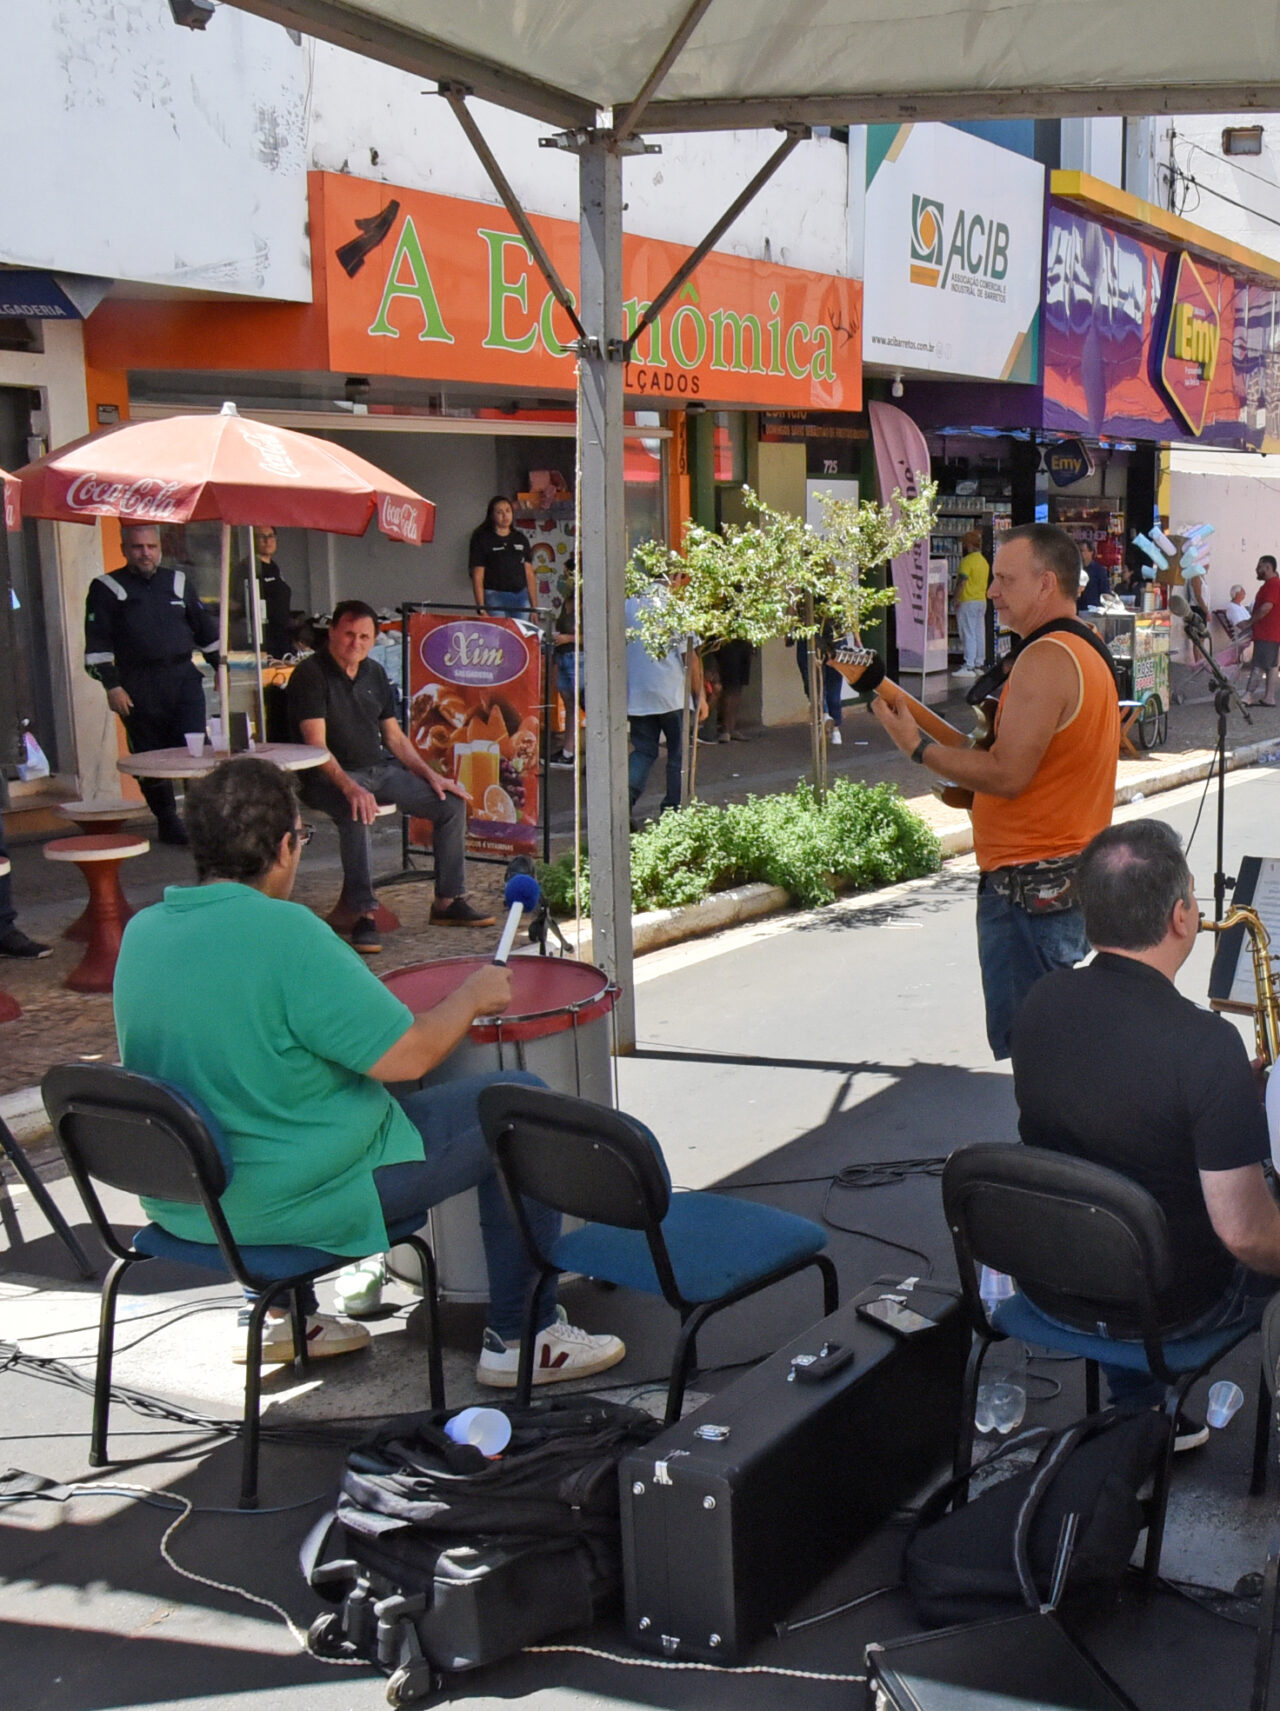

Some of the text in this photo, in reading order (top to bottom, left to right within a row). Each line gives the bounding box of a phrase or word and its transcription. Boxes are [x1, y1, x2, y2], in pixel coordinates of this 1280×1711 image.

[940, 208, 1010, 290] ACIB
[951, 272, 979, 287] ASSOCIAÇÃO
[951, 284, 1007, 303] INDUSTRIAL DE BARRETOS
[368, 214, 837, 383] A Ecnômica
[1174, 302, 1218, 382] Emy
[625, 369, 701, 395] LÇADOS
[823, 459, 839, 474] 725
[1051, 455, 1083, 473] Emy
[66, 472, 178, 518] Coca-Cola
[382, 495, 418, 541] Coca-Cola
[444, 631, 504, 667] Xim
